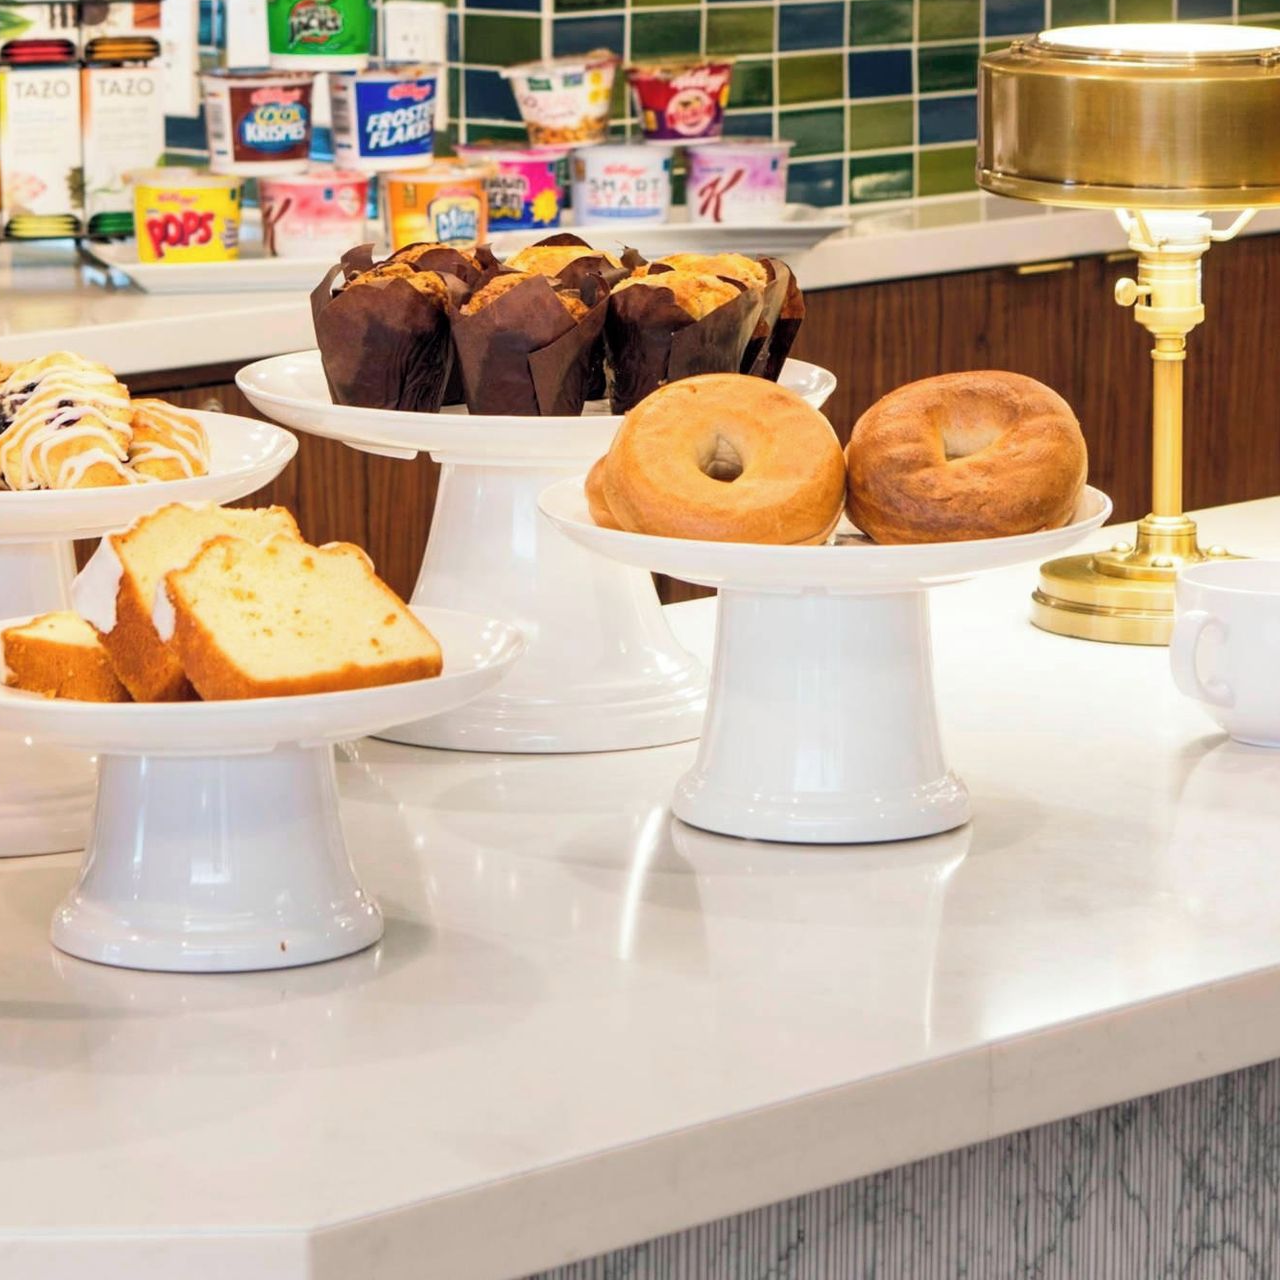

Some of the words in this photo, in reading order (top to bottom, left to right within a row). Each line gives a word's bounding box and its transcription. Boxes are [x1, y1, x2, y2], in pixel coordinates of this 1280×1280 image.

[14, 80, 71, 99] TAZO
[97, 78, 155, 97] TAZO
[244, 119, 307, 143] KRISPIES
[146, 210, 216, 258] POPS
